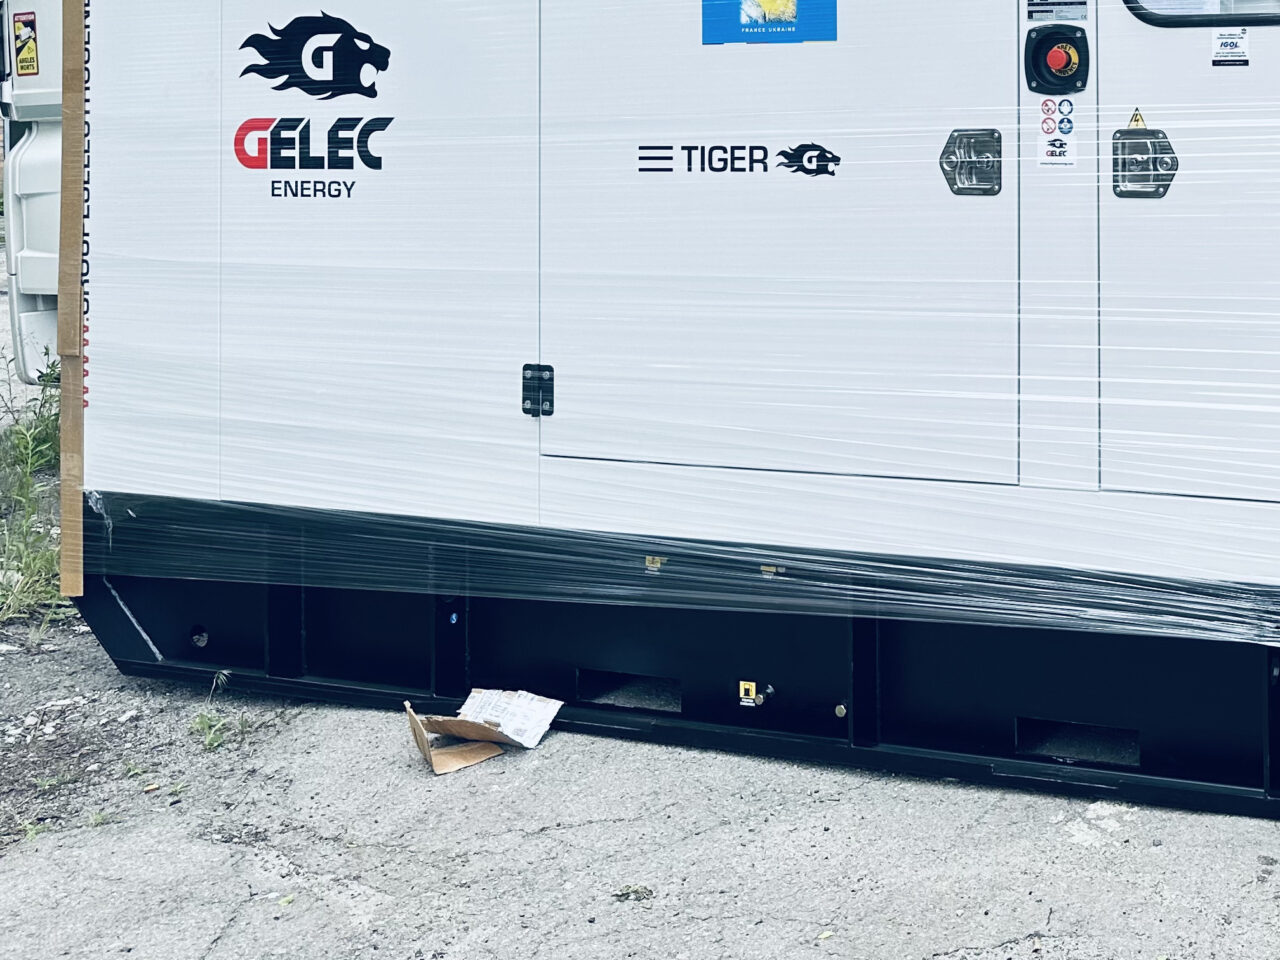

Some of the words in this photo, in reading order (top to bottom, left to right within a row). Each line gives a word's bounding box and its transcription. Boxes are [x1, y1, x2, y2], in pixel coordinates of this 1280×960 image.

[234, 117, 395, 170] GELEC
[680, 145, 769, 173] TIGER
[271, 180, 356, 198] ENERGY
